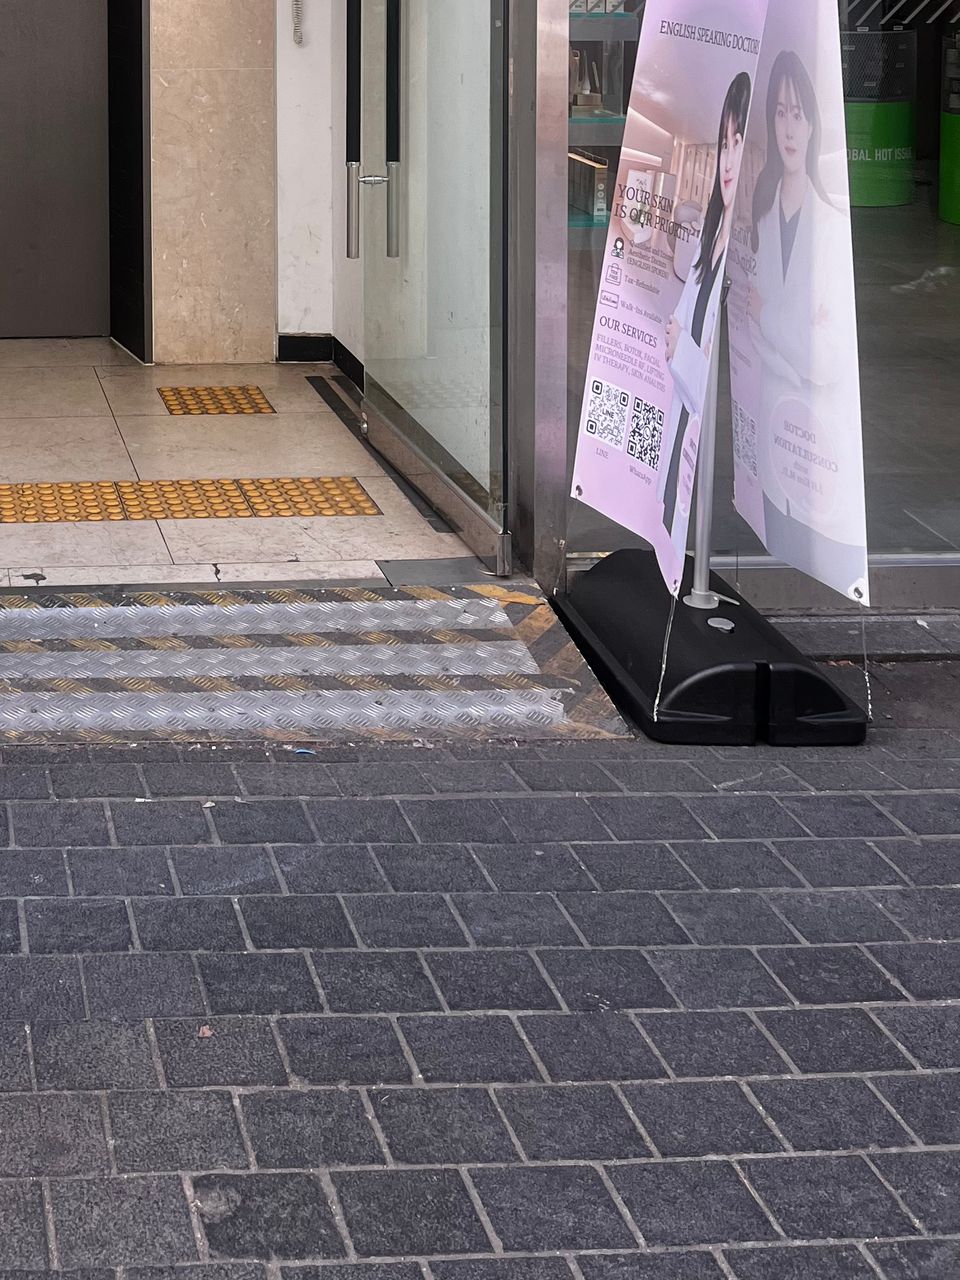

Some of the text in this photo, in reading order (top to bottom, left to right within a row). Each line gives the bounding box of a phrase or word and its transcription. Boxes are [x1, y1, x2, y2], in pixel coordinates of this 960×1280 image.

[659, 20, 697, 40] ENGLISH
[696, 26, 731, 48] SPEAKING
[875, 148, 894, 161] HOT
[618, 183, 651, 206] YOUR
[651, 193, 674, 215] SKIN
[614, 202, 627, 219] IS
[629, 207, 653, 228] OUR
[599, 315, 658, 348] OUR SERVICES
